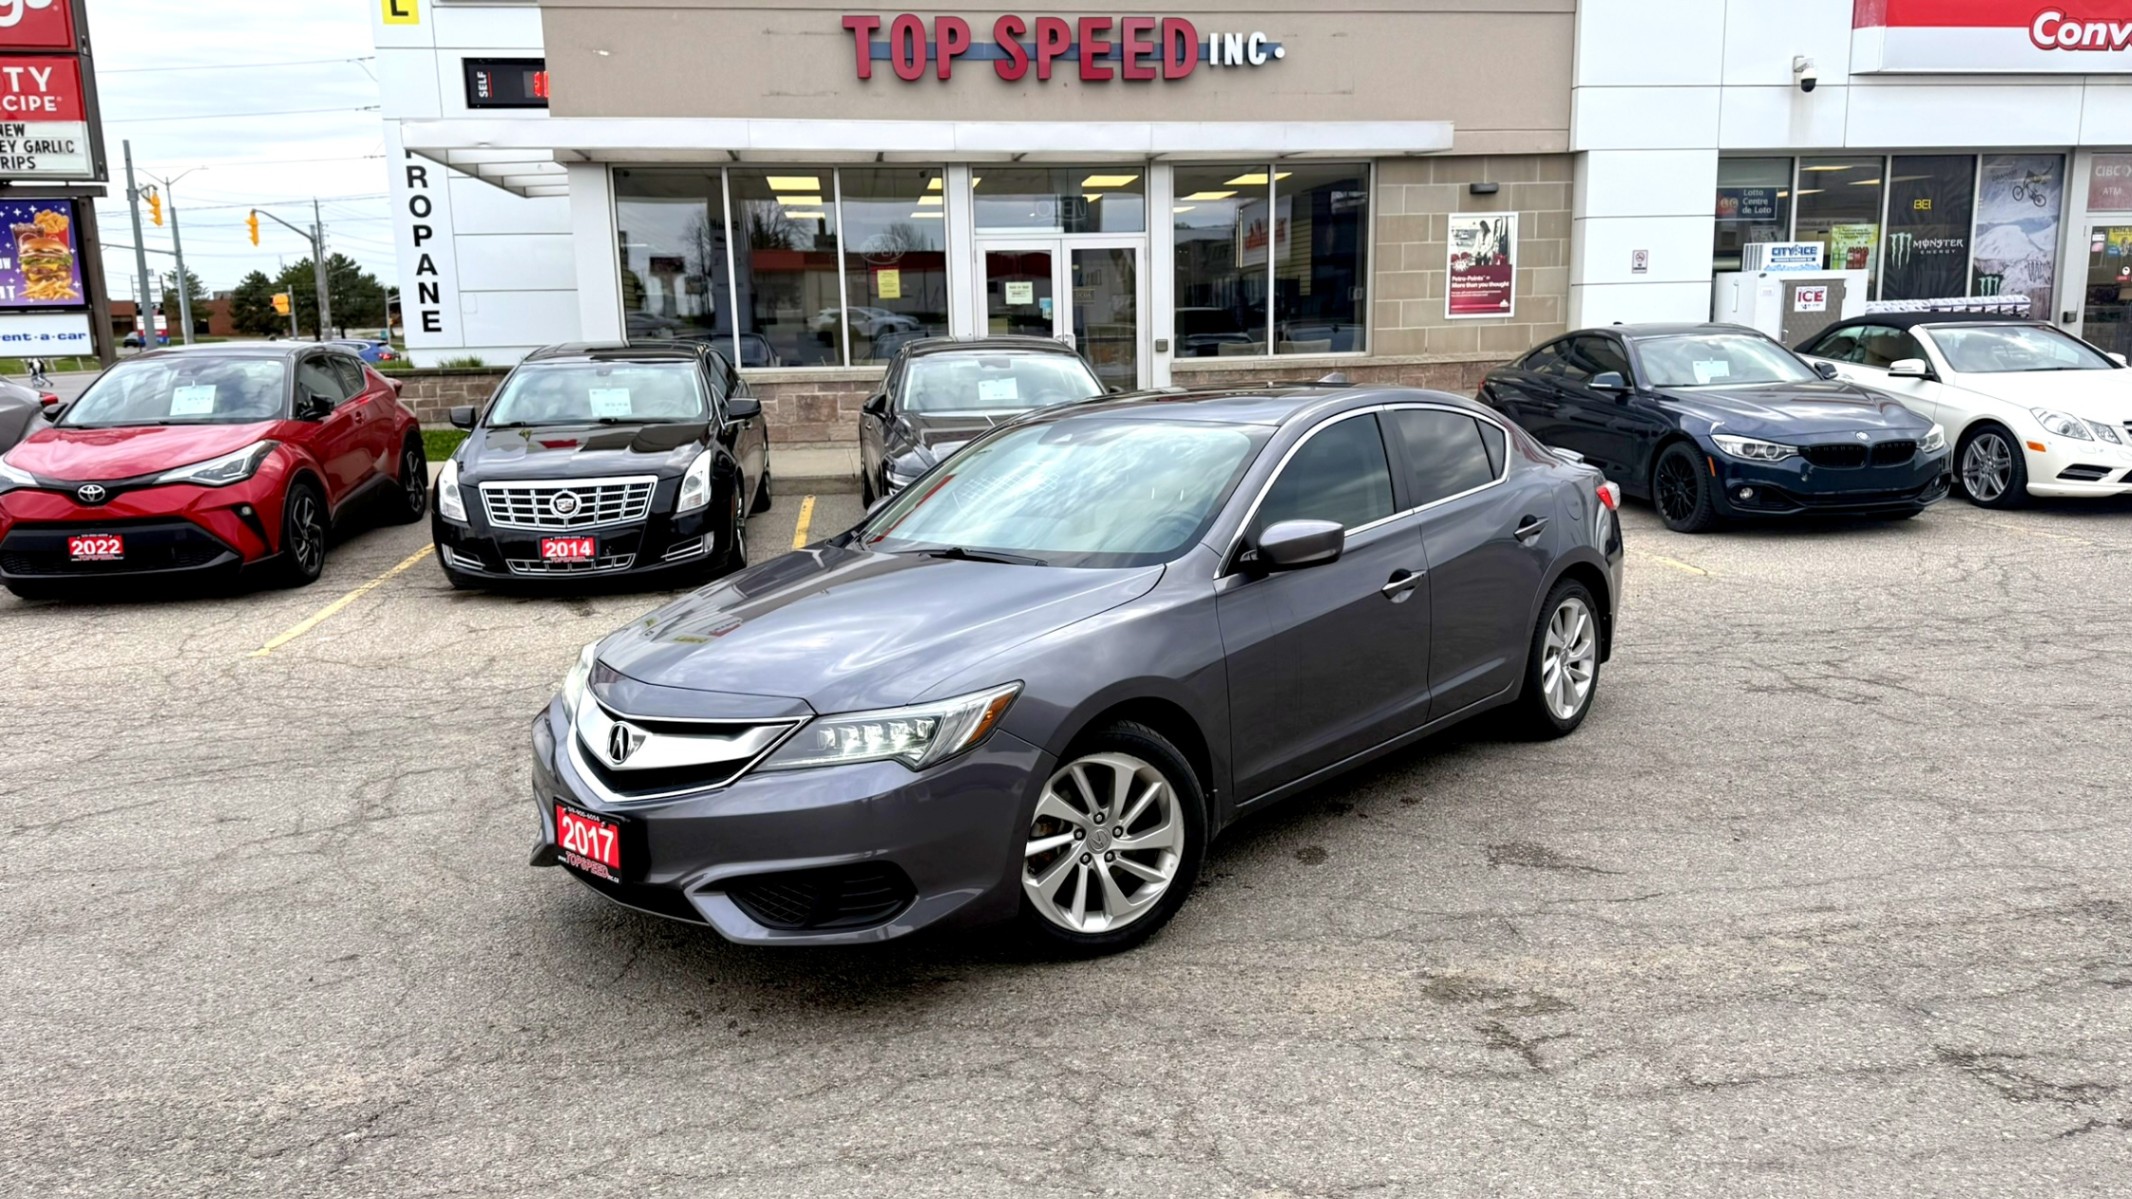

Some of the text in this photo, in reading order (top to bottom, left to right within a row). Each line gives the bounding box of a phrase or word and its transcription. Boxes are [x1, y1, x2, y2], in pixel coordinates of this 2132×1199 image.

[2031, 9, 2132, 48] Conv
[842, 14, 1286, 80] TOP SPEED INC.
[477, 71, 488, 98] SELF
[0, 96, 57, 112] CIPE
[23, 140, 75, 153] GARLIC
[2095, 165, 2121, 177] CIBC
[2103, 186, 2122, 196] ATM
[1035, 199, 1088, 218] OEN
[1742, 198, 1769, 206] Centre
[1742, 206, 1772, 214] de Loto
[1912, 238, 1964, 249] MONSTER
[1771, 246, 1818, 256] CITY ICE
[1797, 290, 1824, 303] ICE
[71, 539, 122, 555] 2022
[545, 540, 592, 557] 2014
[562, 815, 614, 863] 2017
